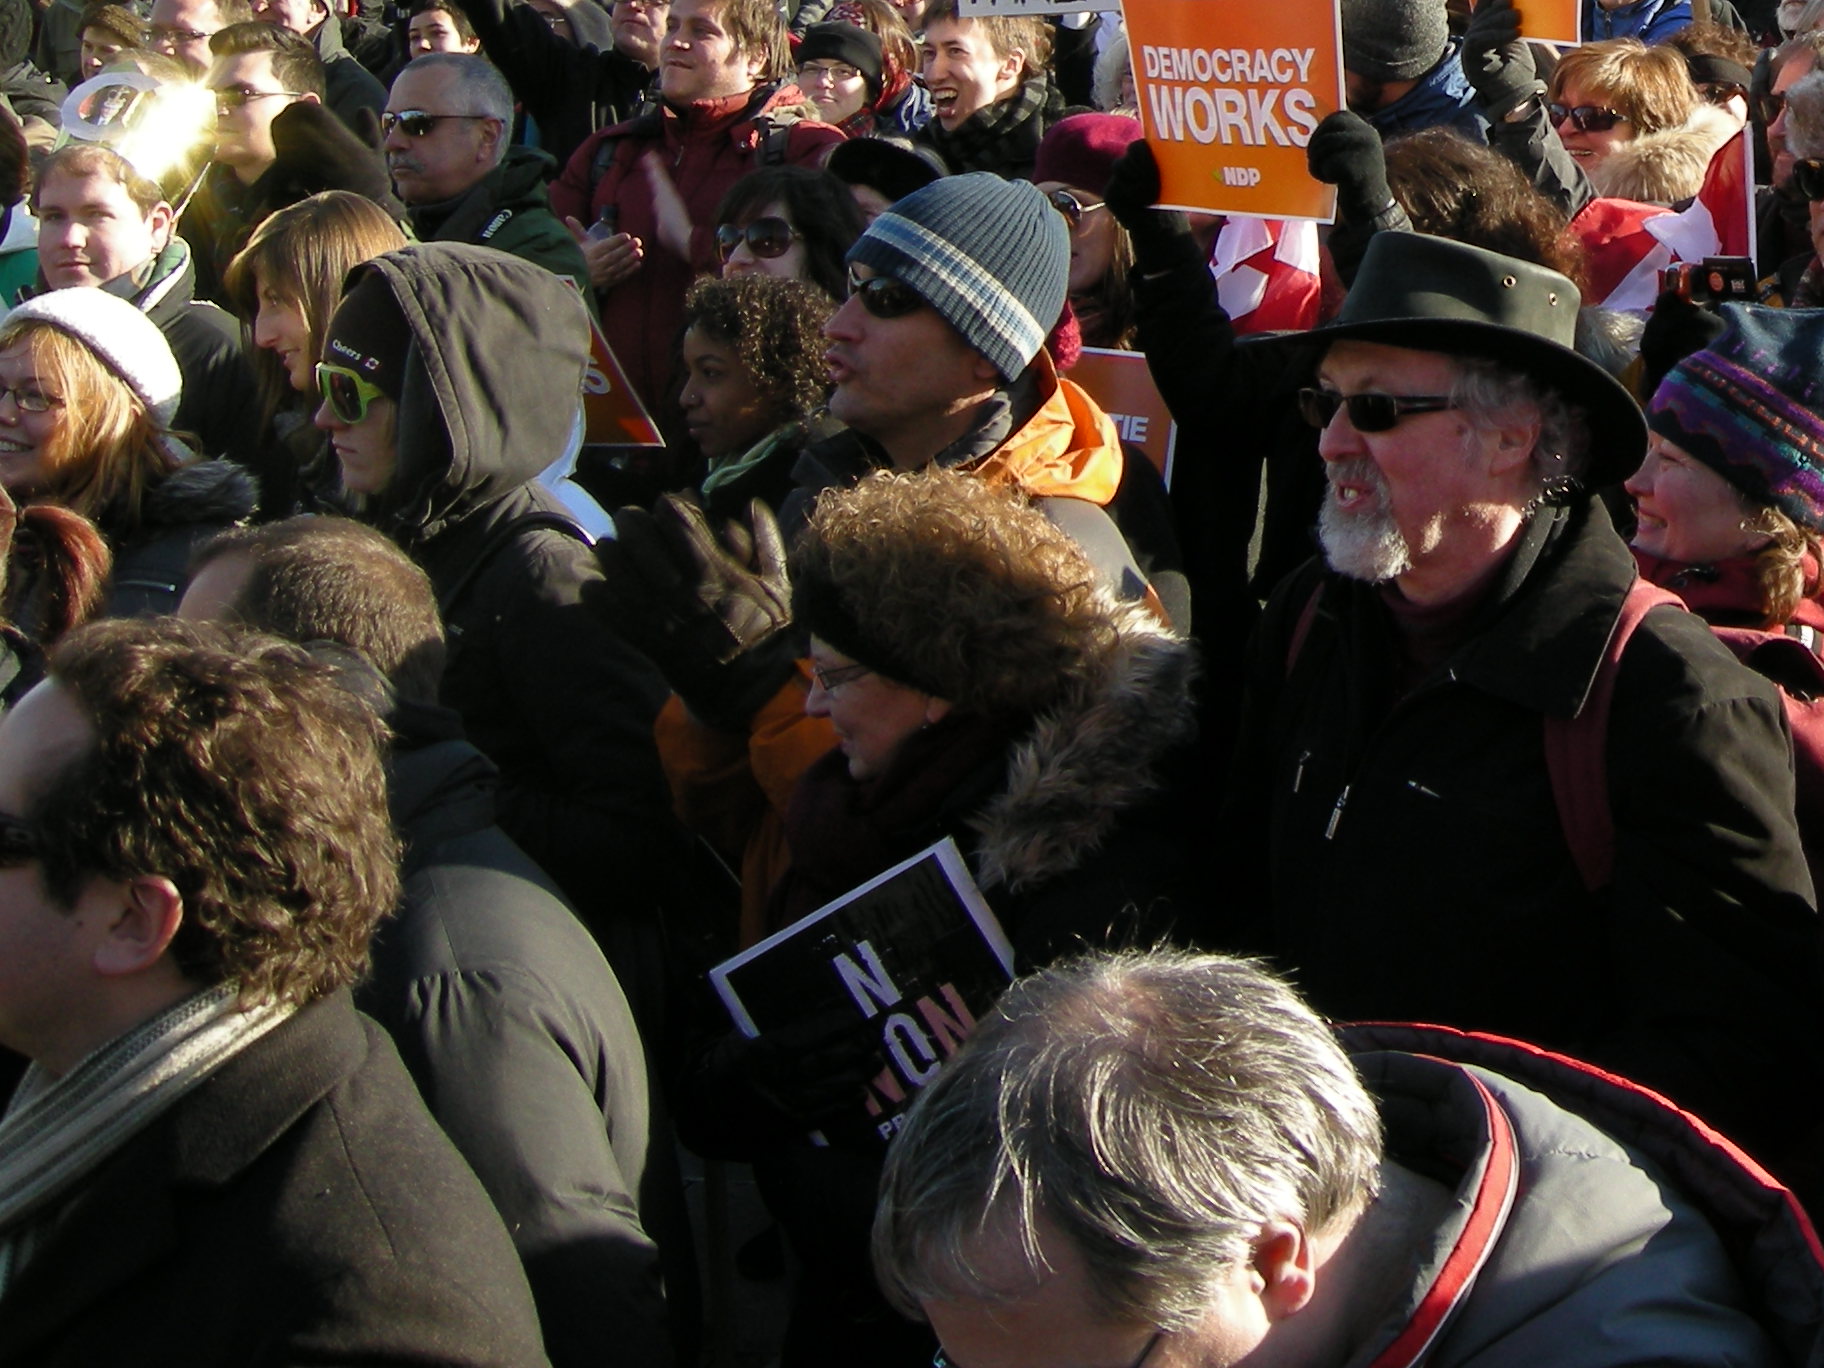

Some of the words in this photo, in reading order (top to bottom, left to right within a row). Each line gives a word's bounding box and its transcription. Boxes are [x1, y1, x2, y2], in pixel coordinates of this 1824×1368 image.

[1142, 44, 1316, 84] DEMOCRACY
[1148, 83, 1320, 149] WORKS
[1223, 166, 1262, 187] NDP
[482, 208, 513, 239] Canon
[332, 338, 362, 361] Cheers
[832, 939, 903, 1019] N
